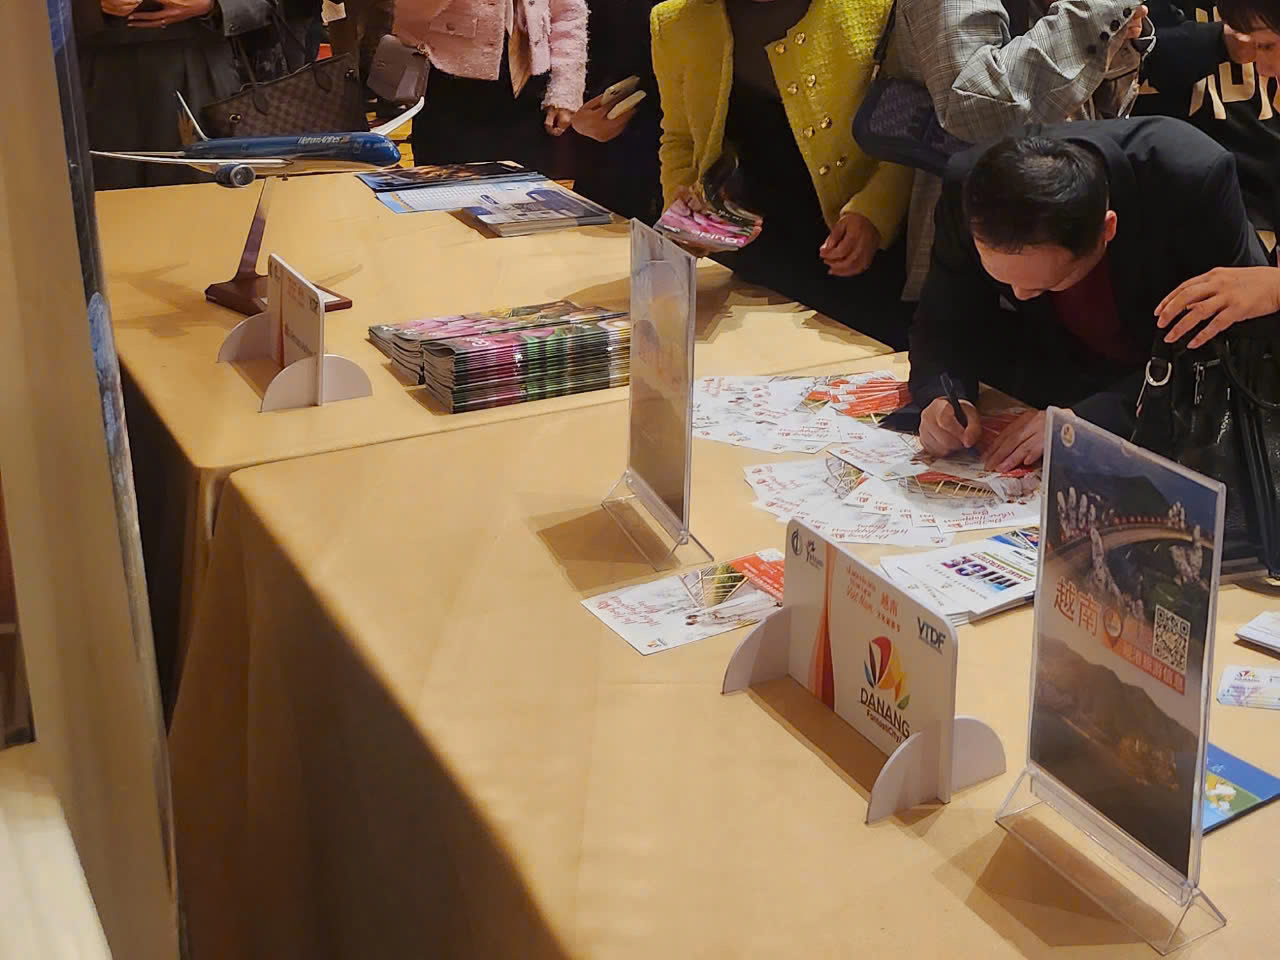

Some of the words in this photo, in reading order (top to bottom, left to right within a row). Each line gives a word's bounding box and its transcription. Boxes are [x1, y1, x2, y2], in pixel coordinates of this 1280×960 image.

[917, 616, 946, 649] VTDF
[1054, 576, 1102, 638] 越南
[860, 687, 910, 739] DANANG
